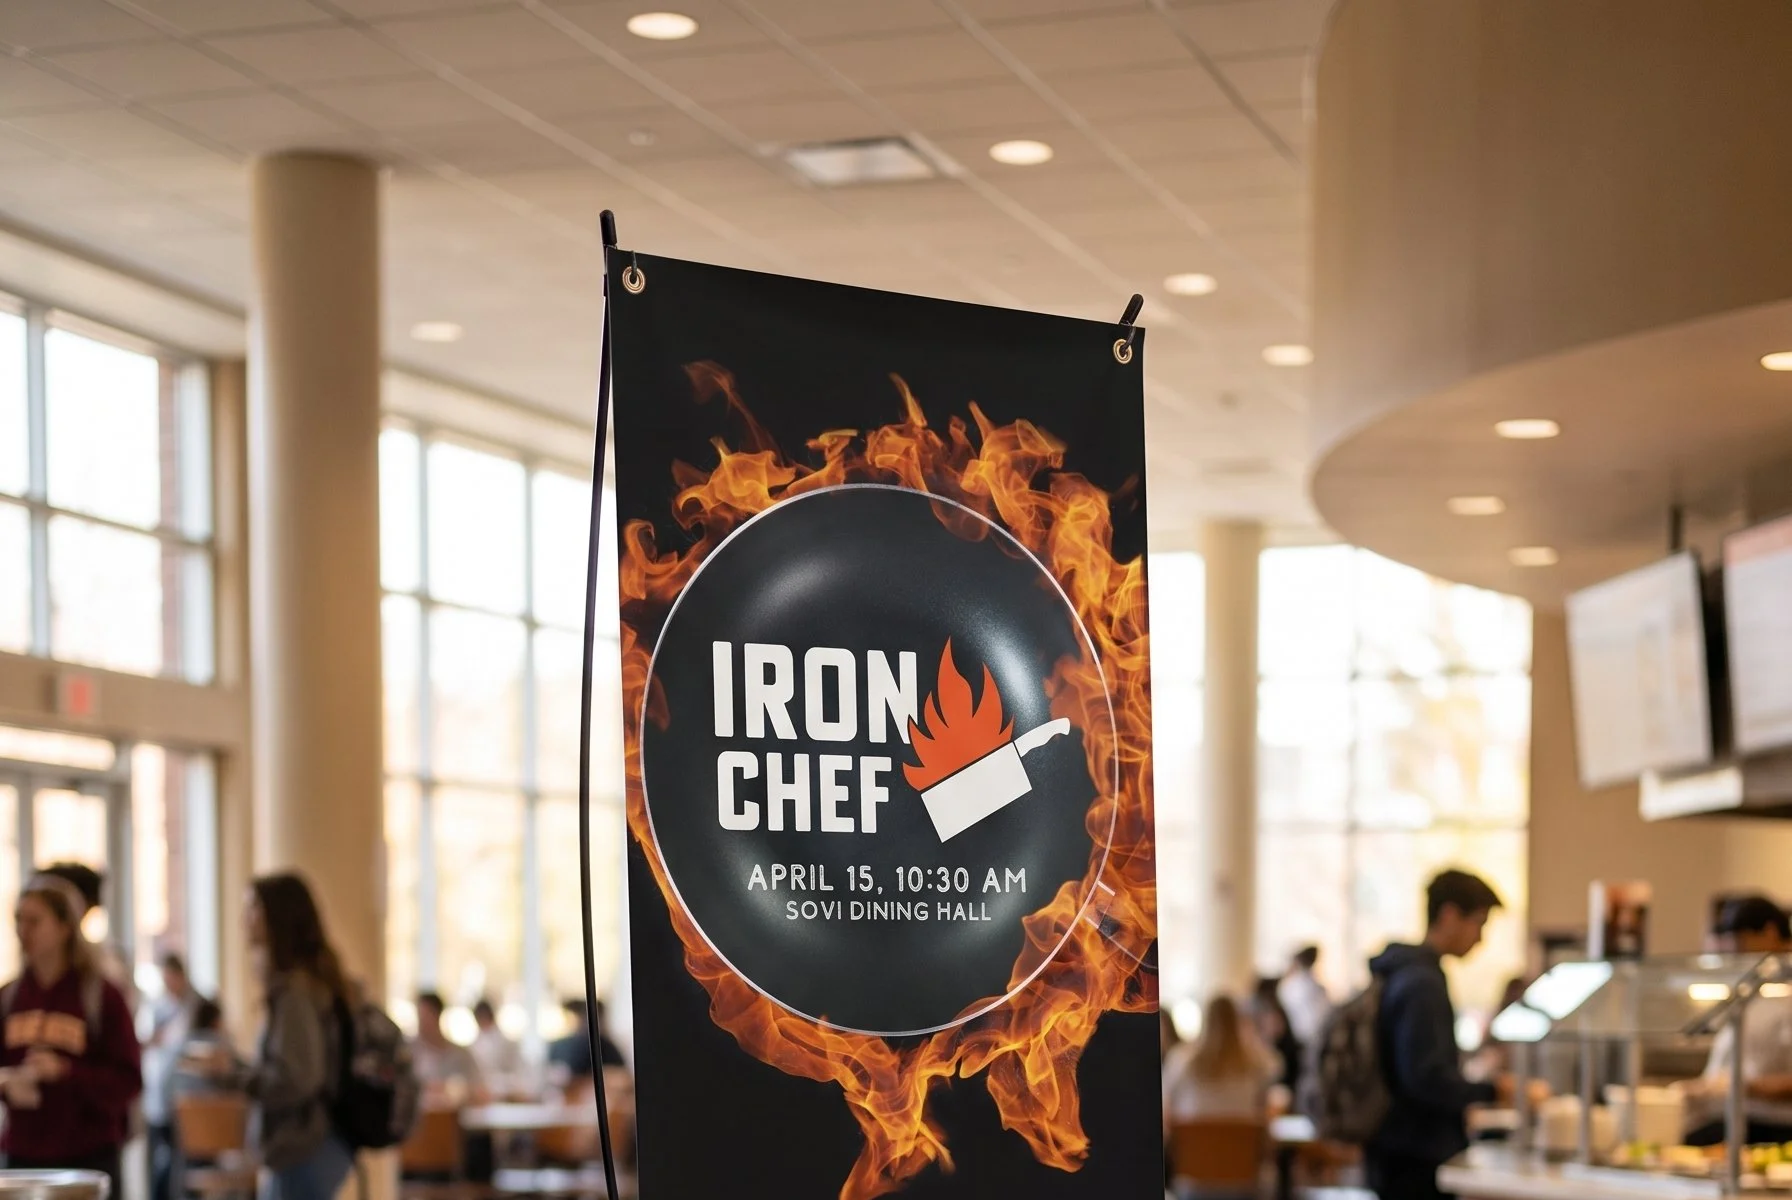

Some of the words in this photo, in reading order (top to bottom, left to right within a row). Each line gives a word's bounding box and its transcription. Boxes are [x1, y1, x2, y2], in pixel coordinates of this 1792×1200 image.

[713, 641, 918, 743] IRON
[718, 751, 891, 833] CHEF
[747, 864, 833, 893] APRIL
[847, 866, 882, 894] 15,
[896, 867, 969, 892] 10:30
[982, 867, 1026, 893] AM
[786, 901, 841, 920] SOVI
[851, 901, 928, 920] DINING
[938, 902, 991, 921] HALL
